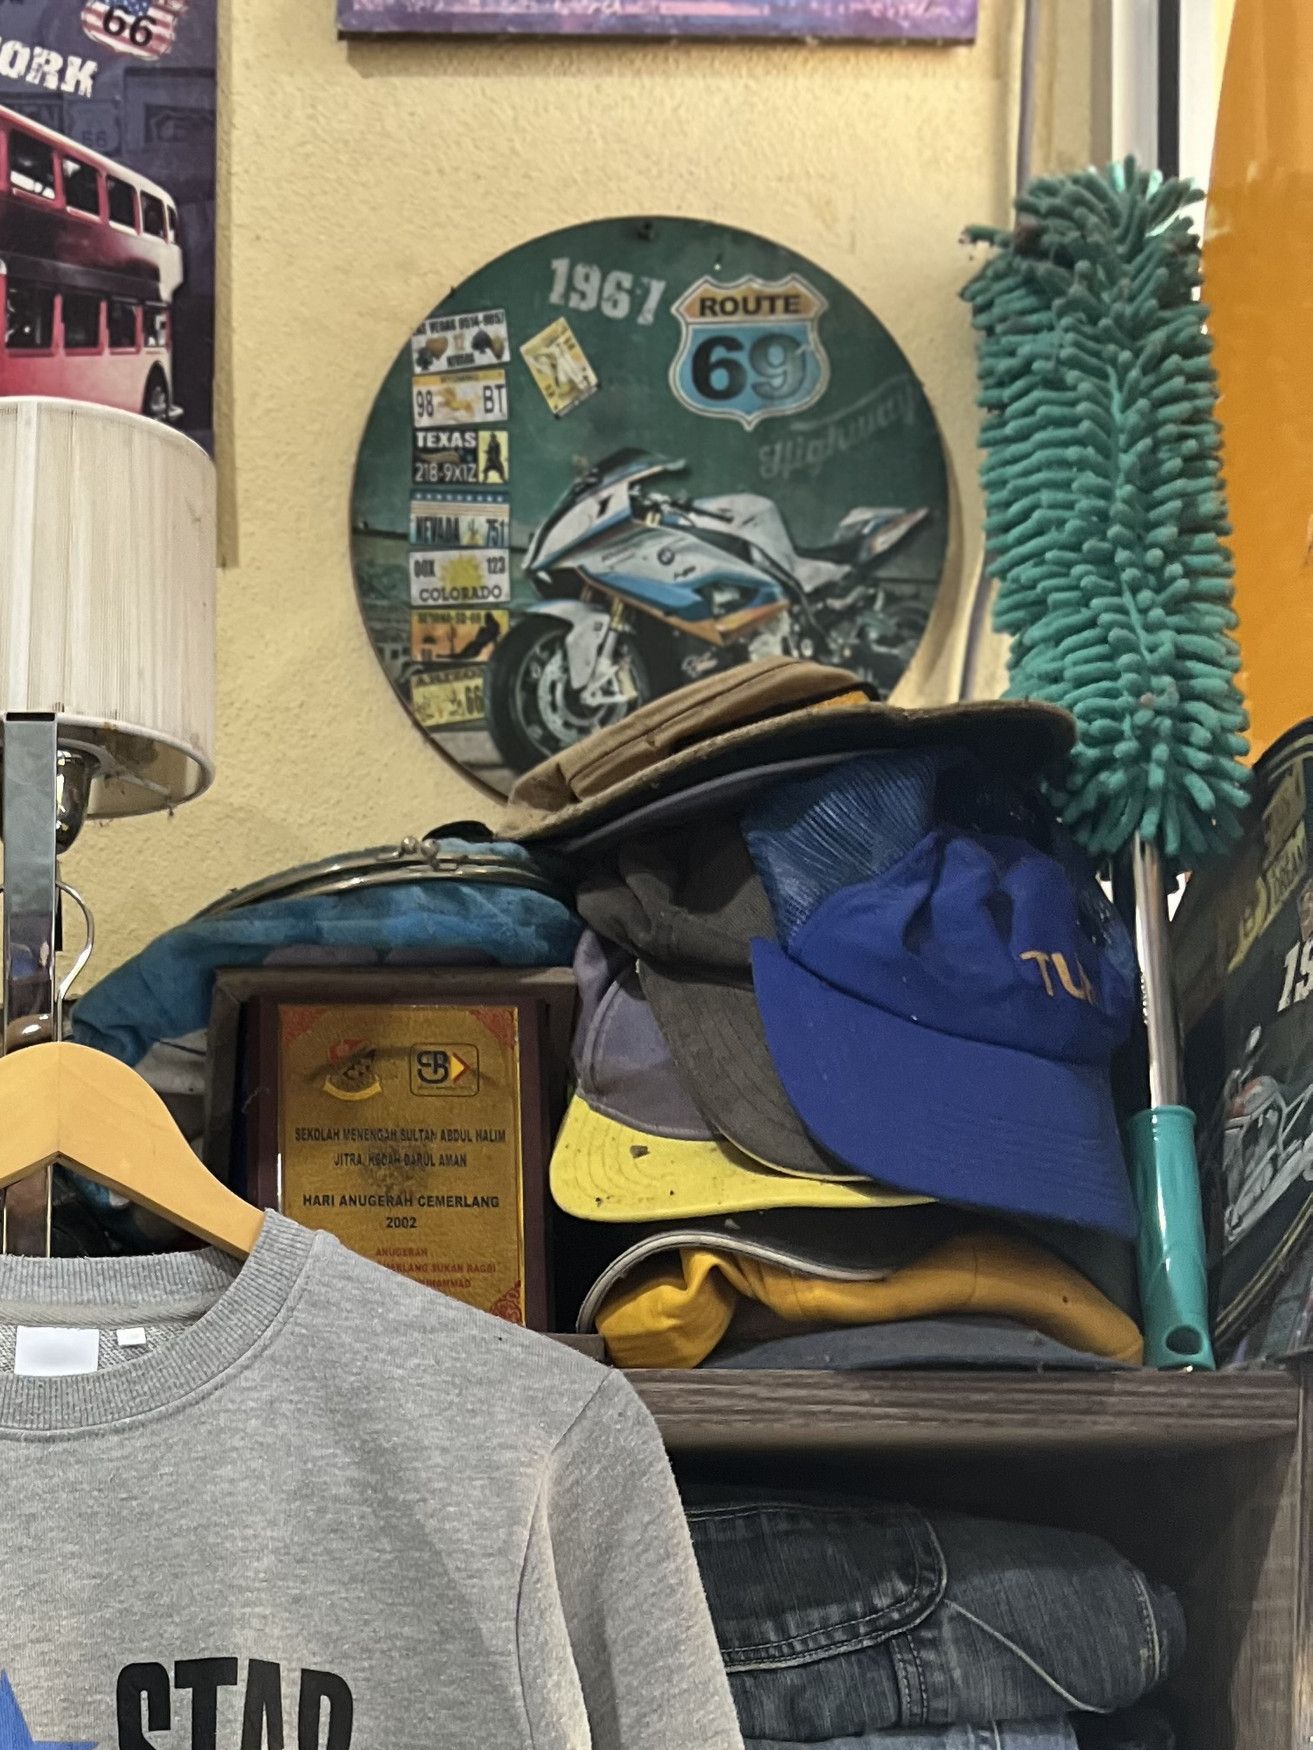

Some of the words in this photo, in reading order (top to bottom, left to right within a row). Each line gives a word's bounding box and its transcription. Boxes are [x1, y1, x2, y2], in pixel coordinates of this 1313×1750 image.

[102, 3, 157, 47] 66
[549, 258, 666, 326] 1967
[699, 295, 801, 317] ROUTE
[691, 333, 807, 401] 69
[416, 390, 434, 418] 98
[483, 384, 506, 414] BT
[415, 431, 477, 448] TEXAS
[419, 585, 503, 602] COLORADO
[295, 1127, 339, 1141] SEKOLAH
[400, 1128, 437, 1142] SULTAN
[440, 1129, 473, 1143] ABDUL
[476, 1129, 506, 1143] HALIM
[439, 1153, 467, 1167] AMAN
[303, 1194, 335, 1207] HARI
[339, 1195, 414, 1208] ANUGERAH
[418, 1194, 500, 1209] CEMERLANG
[386, 1216, 417, 1229] 2002
